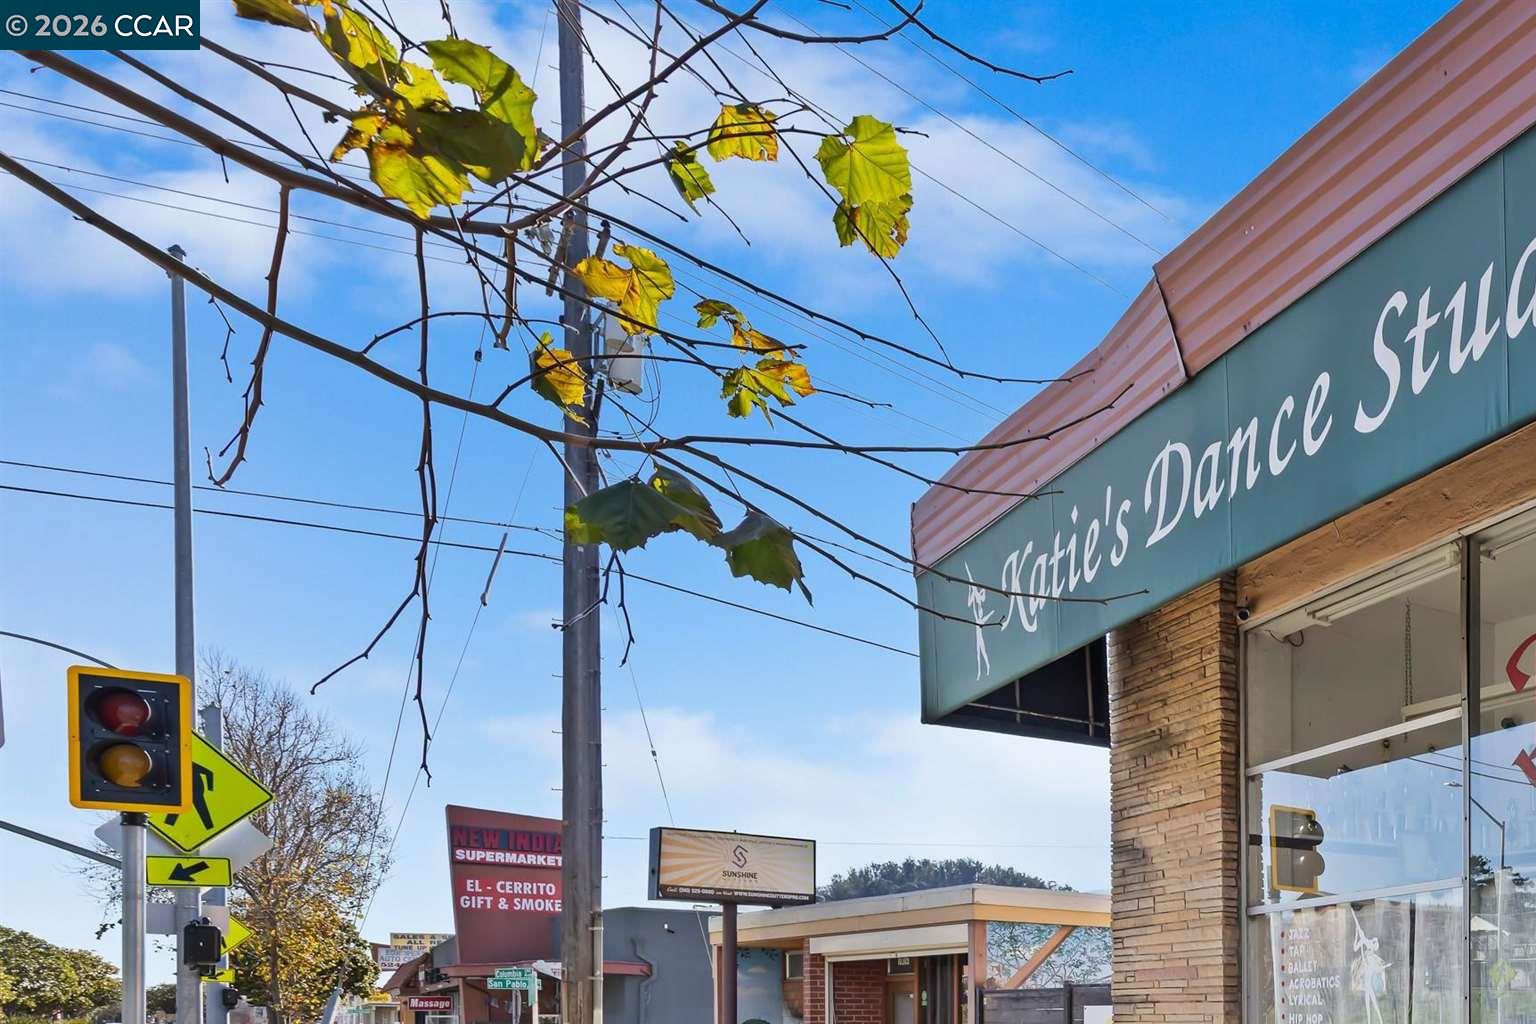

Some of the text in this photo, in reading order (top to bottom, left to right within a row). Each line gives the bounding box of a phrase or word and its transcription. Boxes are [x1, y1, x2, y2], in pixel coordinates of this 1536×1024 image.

[1000, 486, 1131, 632] Katie's
[1145, 371, 1333, 549] Dance
[452, 826, 499, 848] NEW
[455, 849, 562, 866] SUPERMARKET
[722, 870, 758, 879] SUNSHINE
[466, 879, 482, 892] EL
[496, 881, 556, 896] CERRITO
[460, 896, 563, 912] GIFT & SMOKE
[1288, 960, 1318, 974] BALLET
[488, 979, 527, 988] San Pablo
[1288, 975, 1341, 990] ACROBATICS
[410, 998, 450, 1008] Massage
[1287, 994, 1323, 1006] LYRICAL
[1288, 1013, 1323, 1024] HIP HOP
